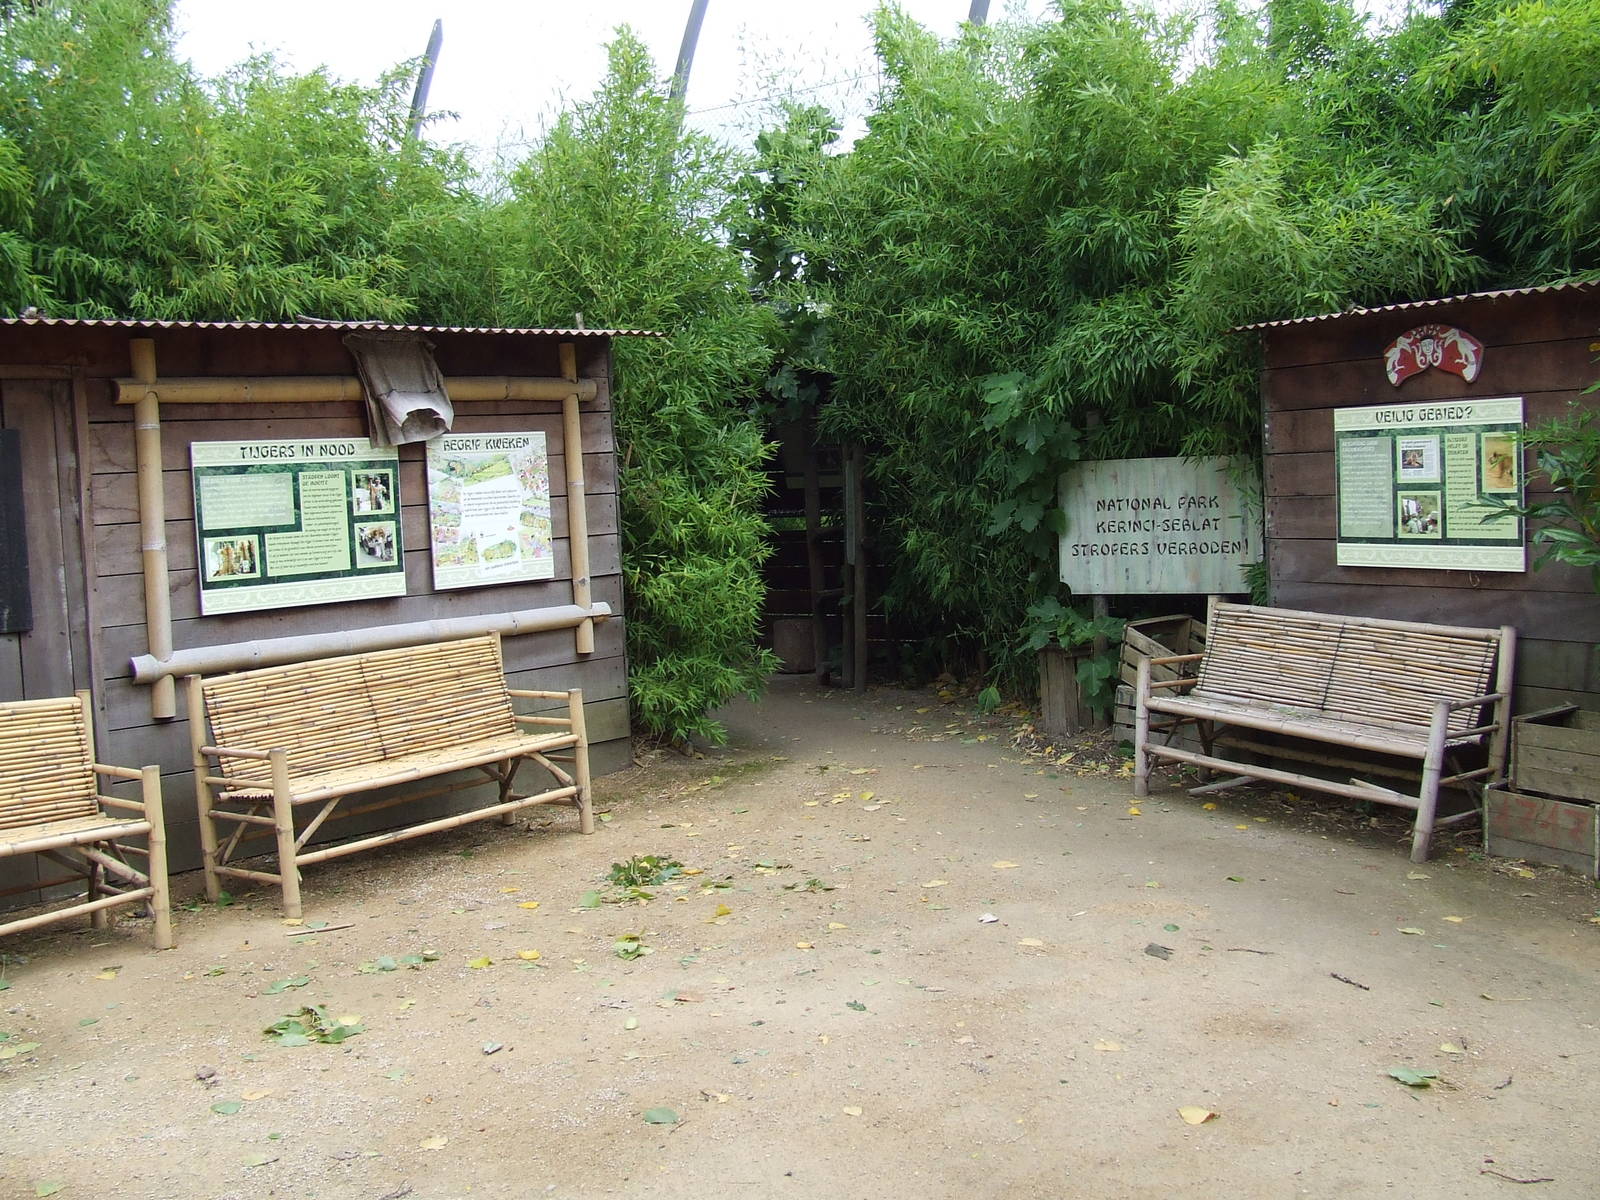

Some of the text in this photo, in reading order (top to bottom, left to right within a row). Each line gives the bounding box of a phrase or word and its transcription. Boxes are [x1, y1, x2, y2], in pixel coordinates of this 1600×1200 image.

[1375, 406, 1472, 423] VEILIG GEBIED?
[240, 443, 355, 459] TIJGERS IN NOOD
[485, 437, 529, 450] KWEKEN
[1096, 495, 1220, 512] NATIONAL PARK
[1096, 518, 1221, 534] KERINCI-SEBLAT
[1071, 538, 1249, 557] STROPERS VERBODEN!
